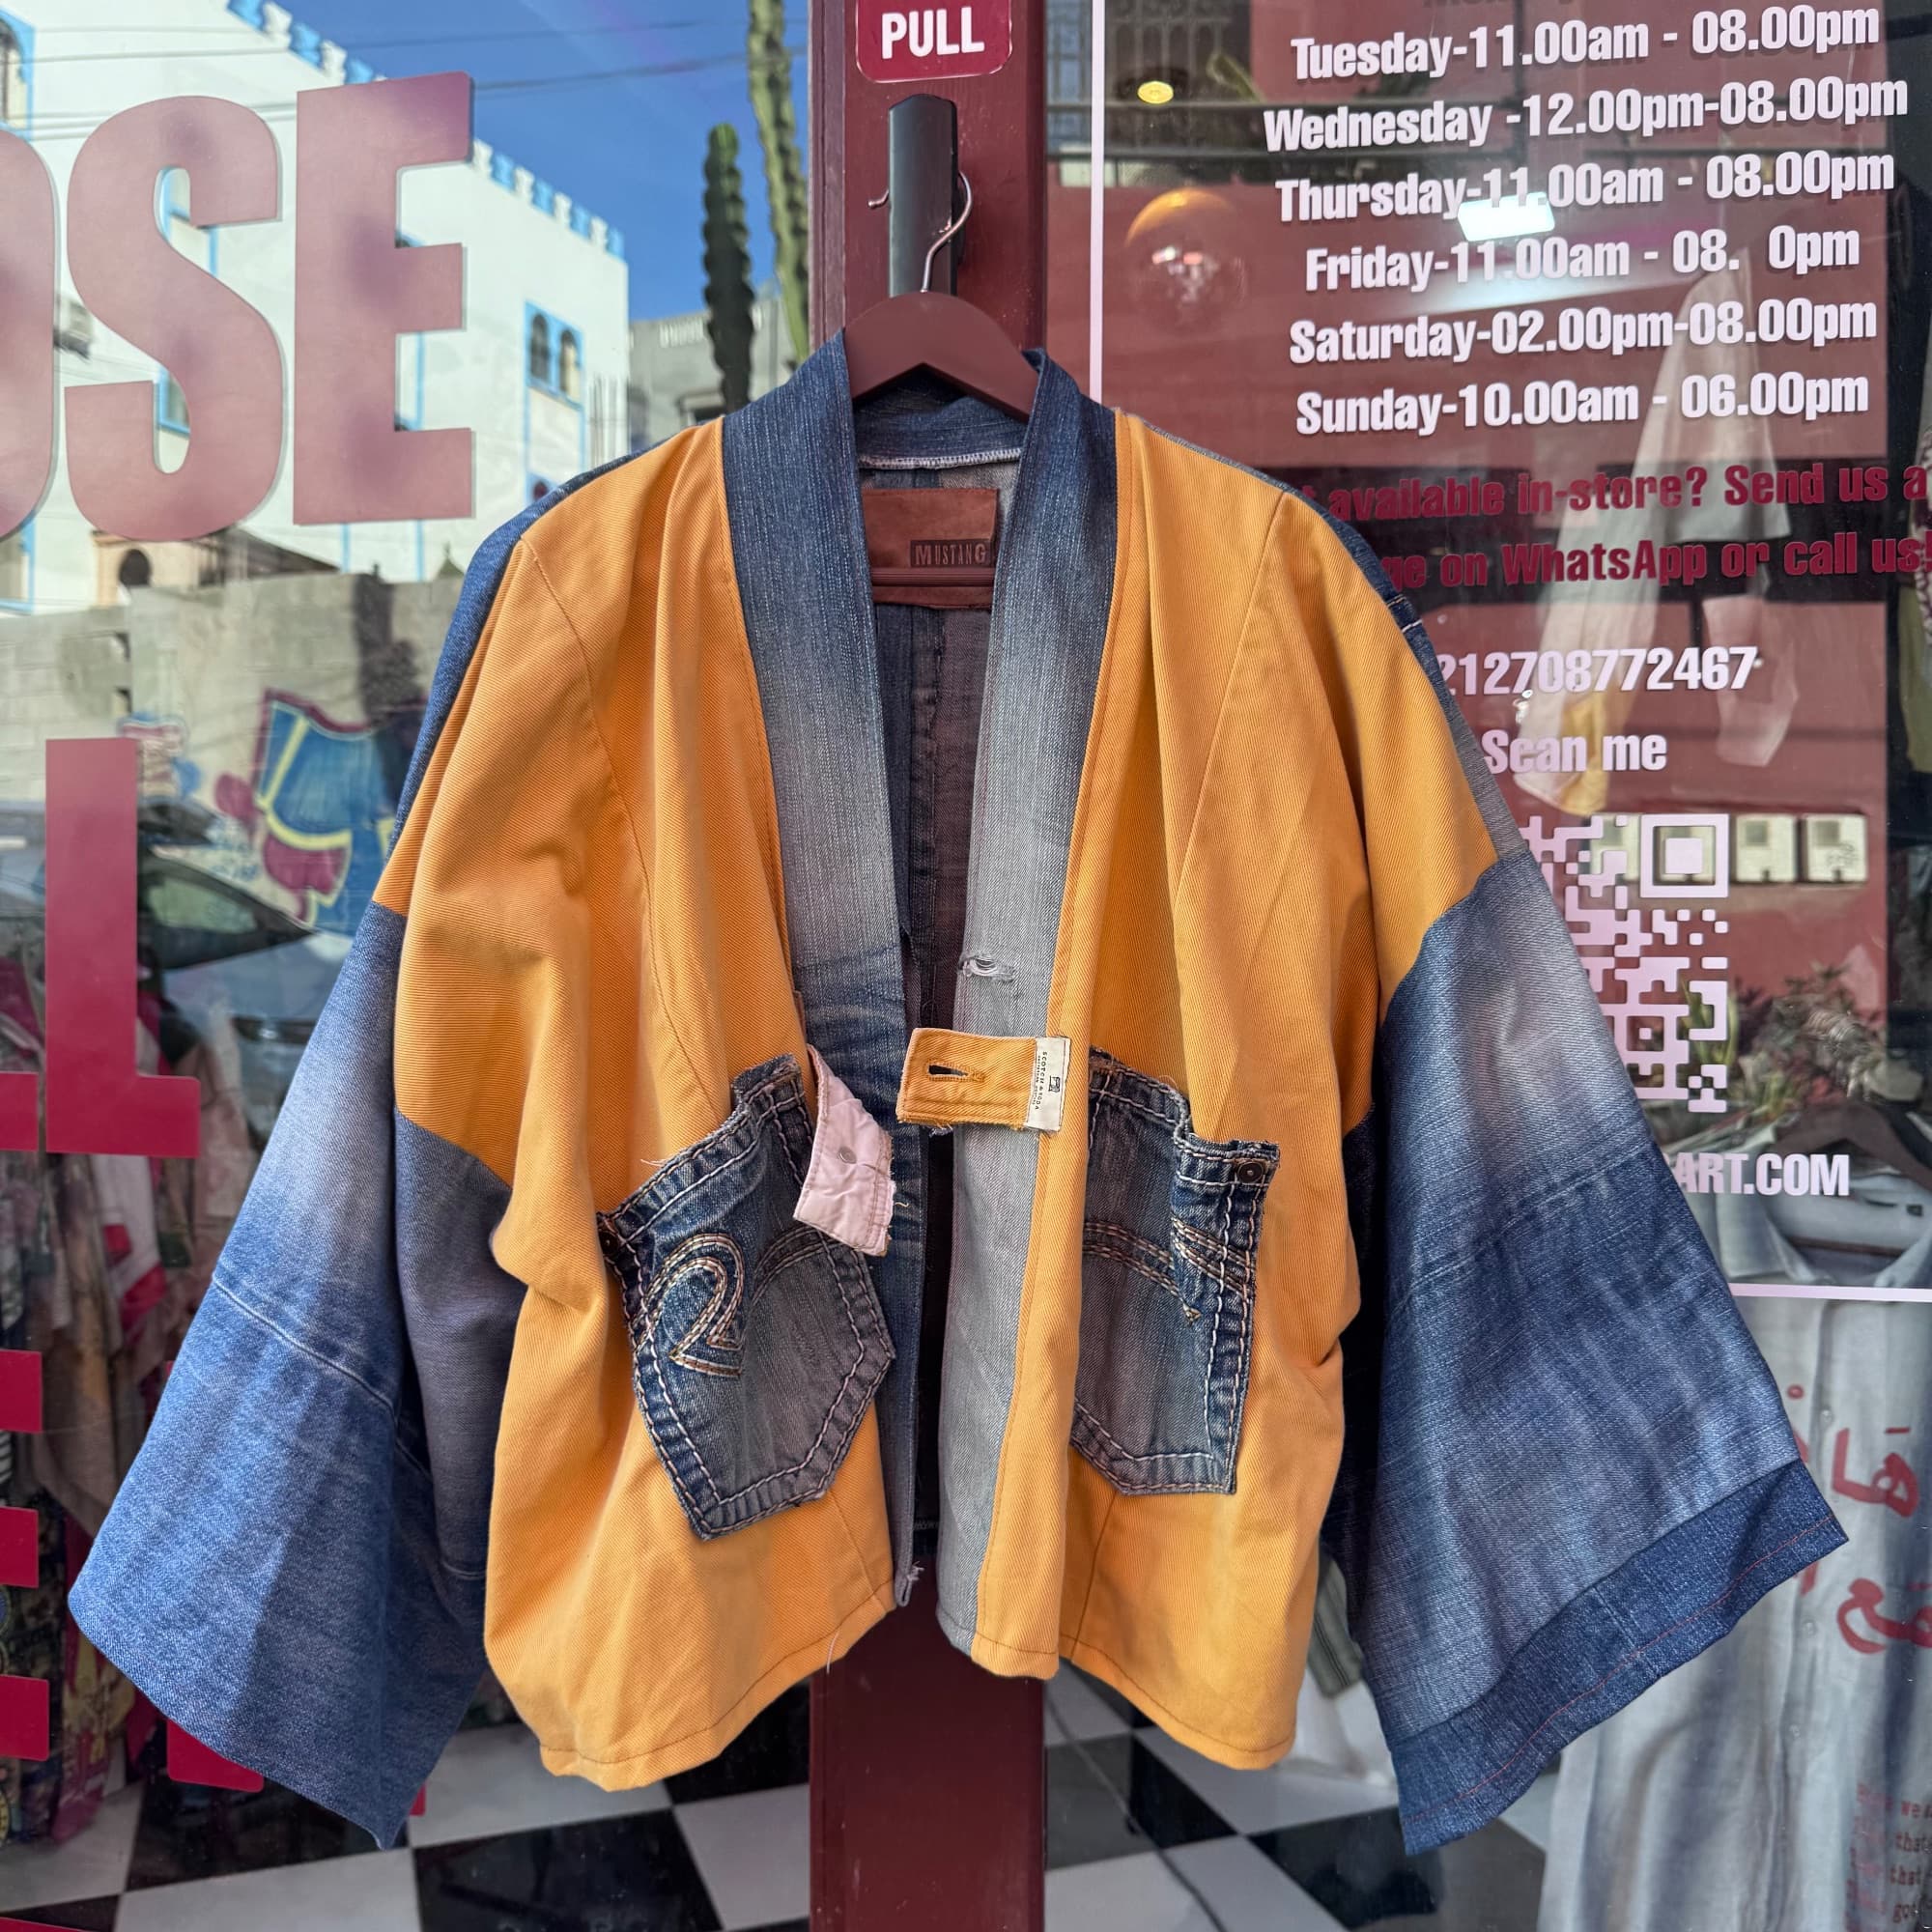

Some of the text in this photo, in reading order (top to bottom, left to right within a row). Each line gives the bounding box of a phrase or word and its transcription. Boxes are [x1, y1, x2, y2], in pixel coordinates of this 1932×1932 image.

[882, 6, 985, 59] PULL
[1291, 19, 1648, 80] Tuesday-11.00am
[1691, 4, 1879, 54] 08.00pm
[1264, 76, 1908, 153] Wednesday -12.00pm-08.00pm
[1706, 150, 1894, 200] 08.00pm
[1306, 237, 1629, 293] Friday-11.00am
[0, 71, 474, 543] SE
[1290, 298, 1877, 364] Saturday-02.00pm-08.00pm
[1295, 379, 1638, 437] Sunday-10.00am
[1681, 372, 1868, 421] 06.00pm
[1328, 463, 1927, 522] available in-store? Send us a
[916, 543, 986, 565] MUSTANG
[1440, 552, 1489, 587] on
[1501, 539, 1707, 587] WhatsApp
[1720, 542, 1770, 578] or
[1784, 531, 1859, 575] call
[1481, 729, 1668, 775] Scan me
[1662, 1152, 1850, 1197] ART.COM
